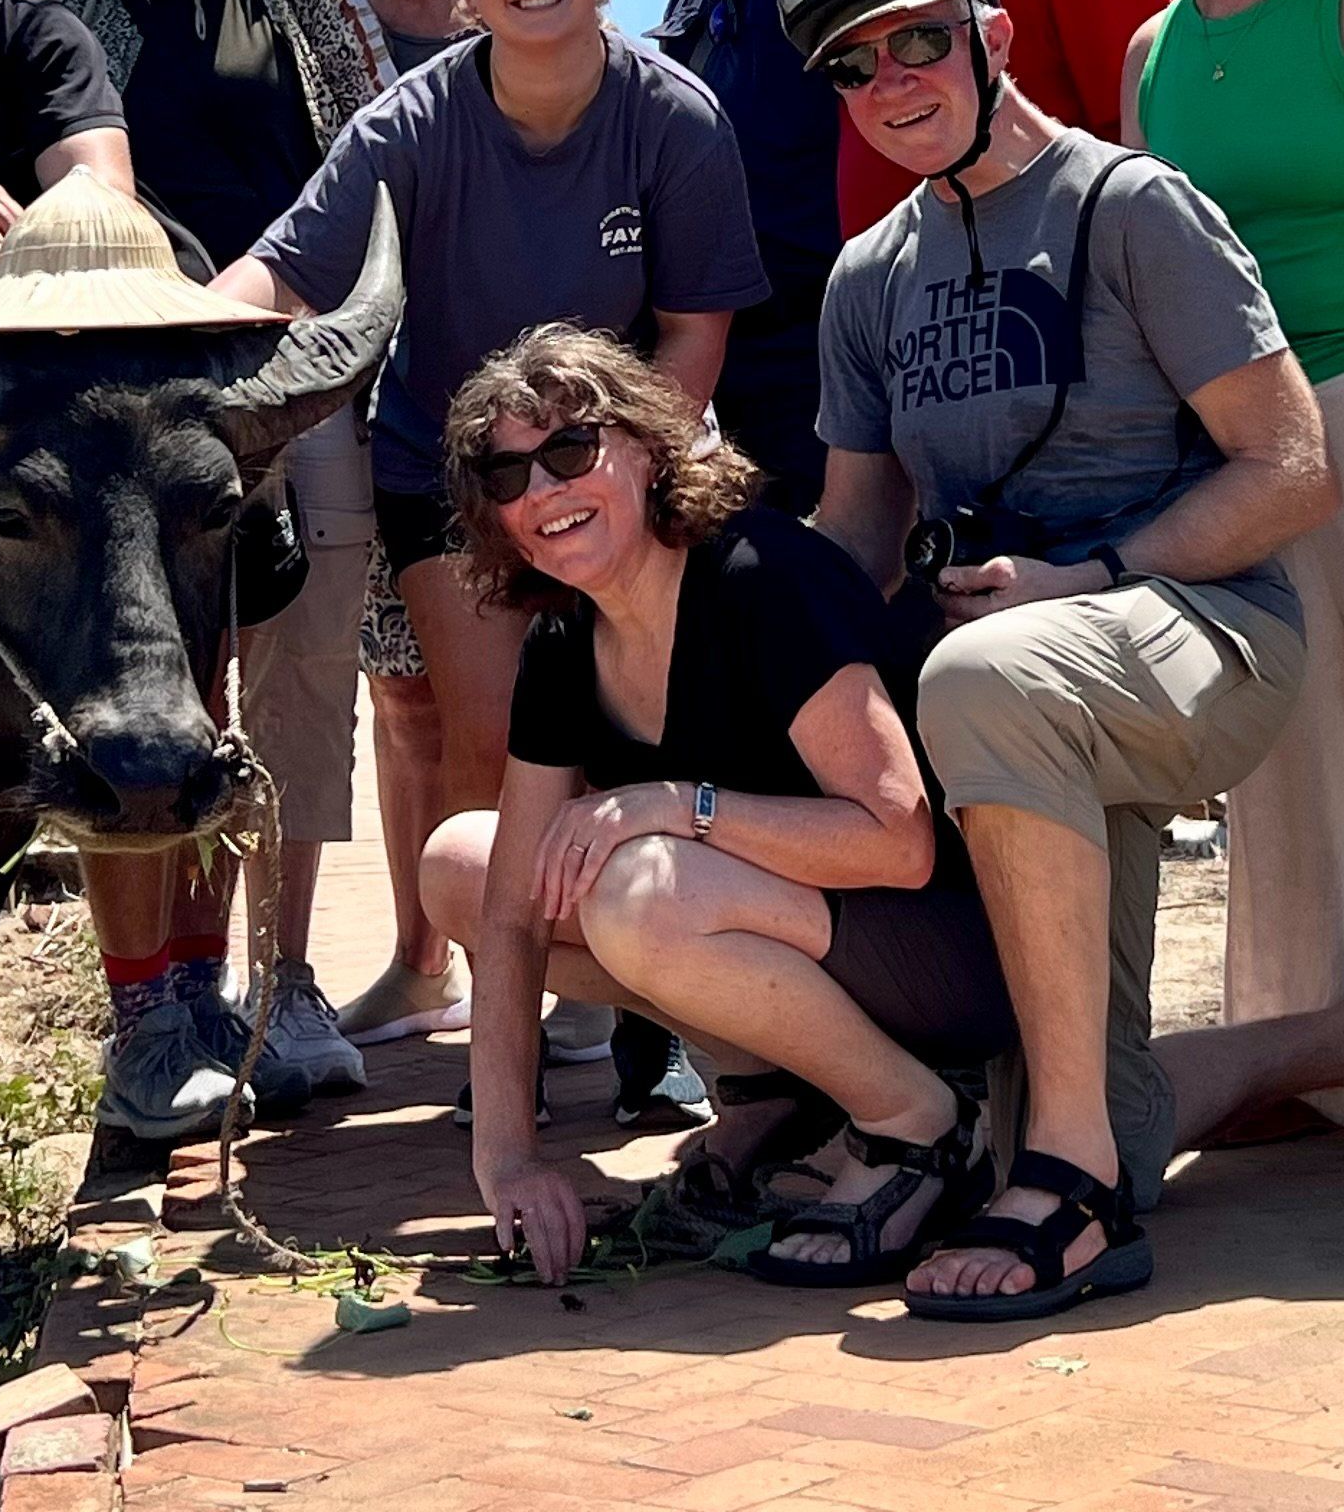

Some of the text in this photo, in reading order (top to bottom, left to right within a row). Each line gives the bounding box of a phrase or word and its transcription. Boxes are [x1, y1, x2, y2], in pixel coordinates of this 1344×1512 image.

[925, 270, 998, 322] THE
[885, 311, 996, 377] NORTH
[902, 353, 994, 413] FACE
